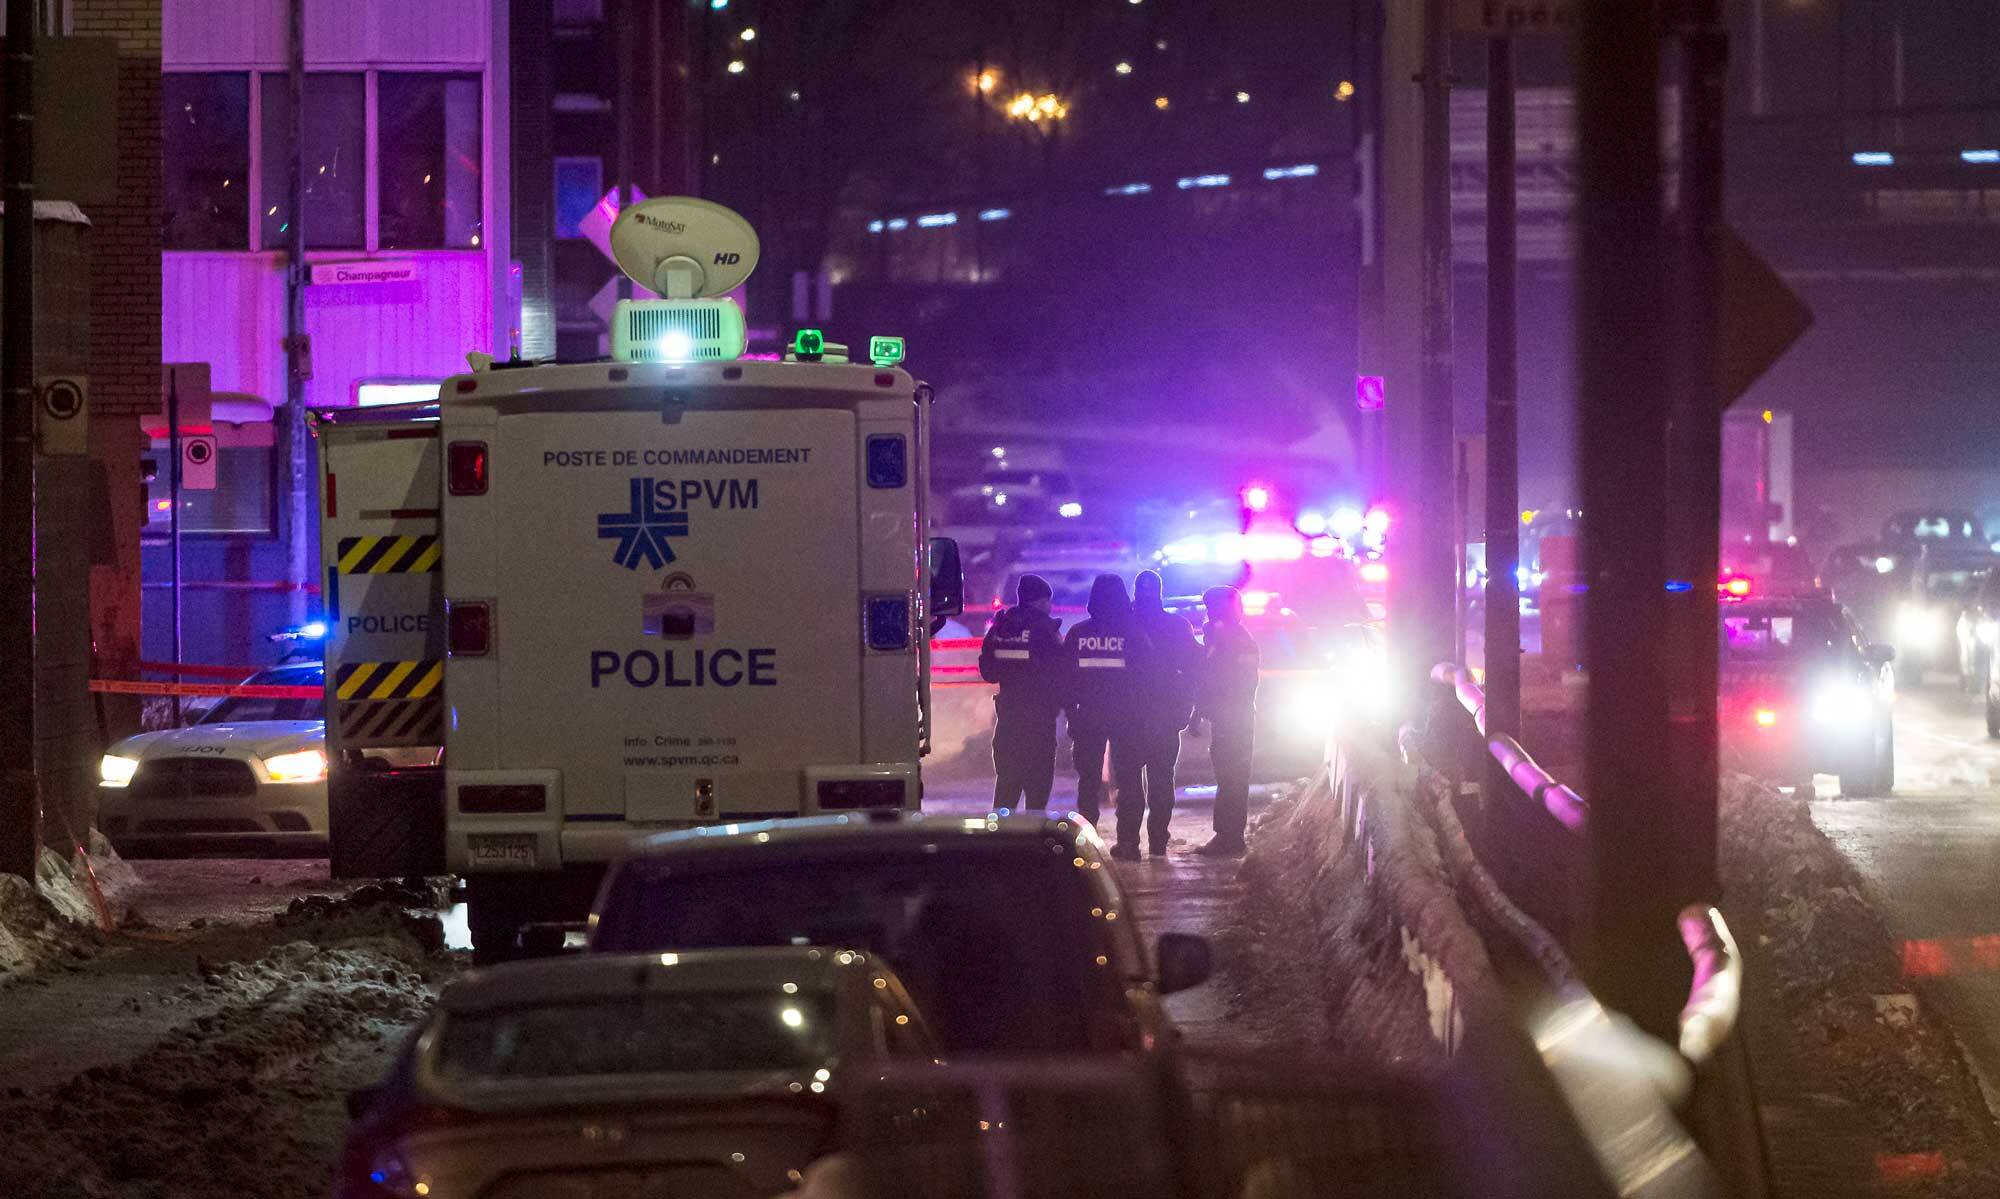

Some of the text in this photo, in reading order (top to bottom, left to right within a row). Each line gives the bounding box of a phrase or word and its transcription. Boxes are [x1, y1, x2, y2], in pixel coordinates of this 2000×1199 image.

[713, 253, 740, 265] HD
[336, 269, 411, 281] Champagneur
[543, 448, 811, 467] POSTE DE COMMANDEMENT
[654, 478, 759, 512] SPVM
[347, 614, 430, 634] POLICE
[1078, 637, 1125, 651] POLICE
[591, 648, 777, 688] POLICE
[654, 735, 691, 747] Crime
[623, 755, 739, 768] www.spvm.qc.ca
